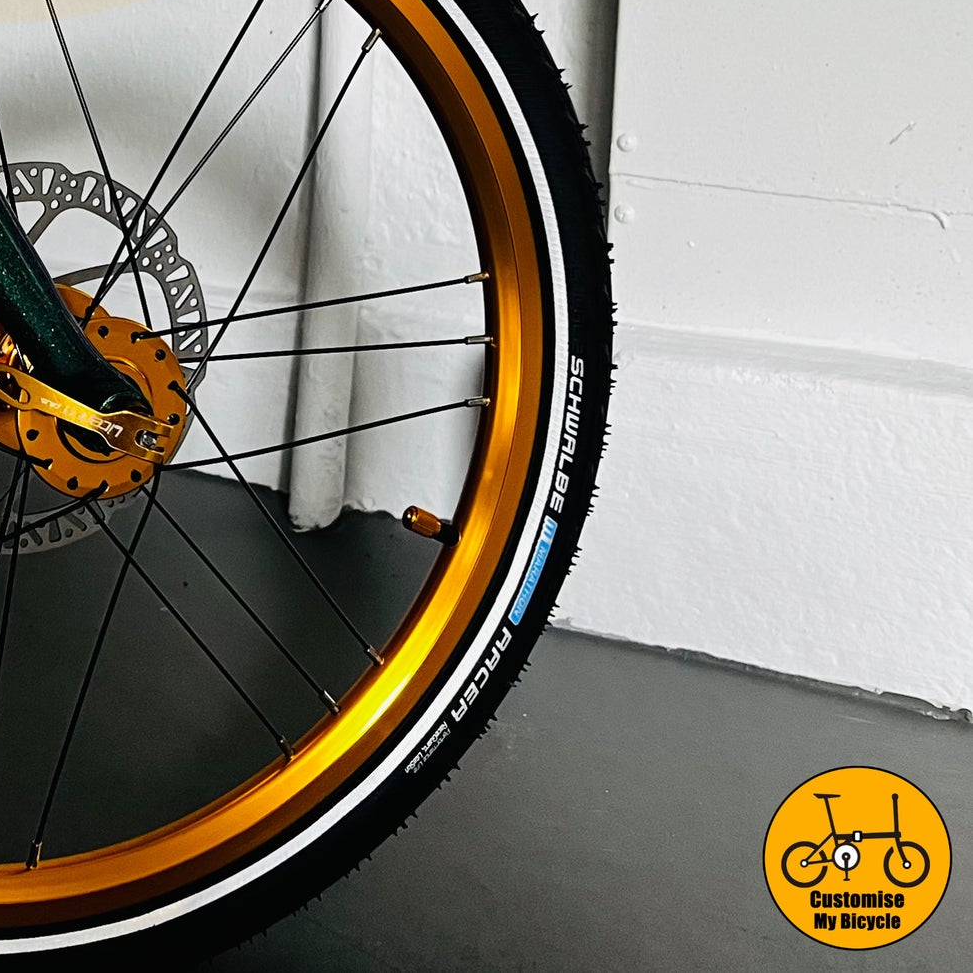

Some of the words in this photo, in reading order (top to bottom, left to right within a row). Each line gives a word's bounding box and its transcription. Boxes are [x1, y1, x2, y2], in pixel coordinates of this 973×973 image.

[549, 355, 584, 514] SCHWALBE
[513, 544, 548, 618] MARATHON
[450, 626, 513, 722] RACER
